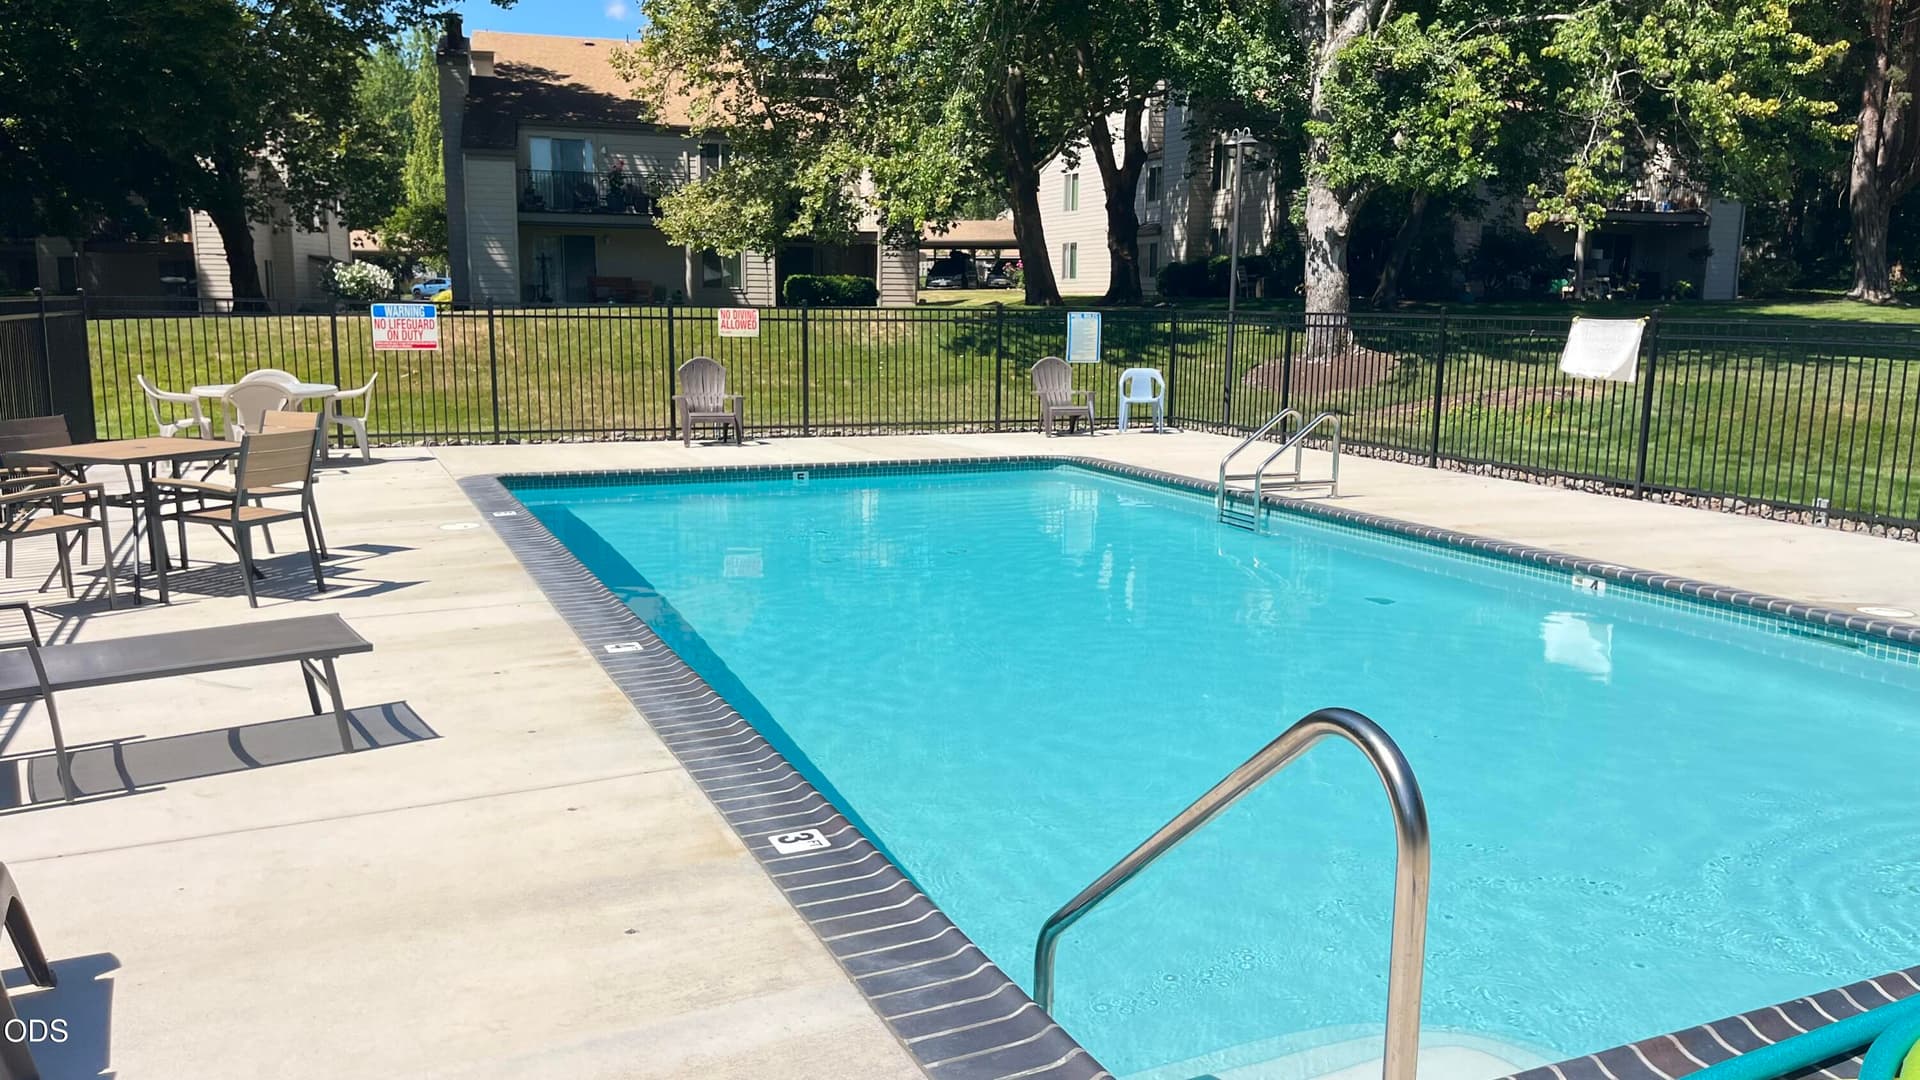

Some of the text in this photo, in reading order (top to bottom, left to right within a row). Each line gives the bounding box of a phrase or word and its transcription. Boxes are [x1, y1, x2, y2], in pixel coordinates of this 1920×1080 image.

[384, 305, 425, 318] WARNING
[720, 309, 757, 319] NO DIVING
[374, 319, 435, 329] NO LIFEGUARD
[720, 320, 757, 329] ALLOWED
[387, 330, 424, 340] ON DUTY
[778, 832, 814, 843] 3
